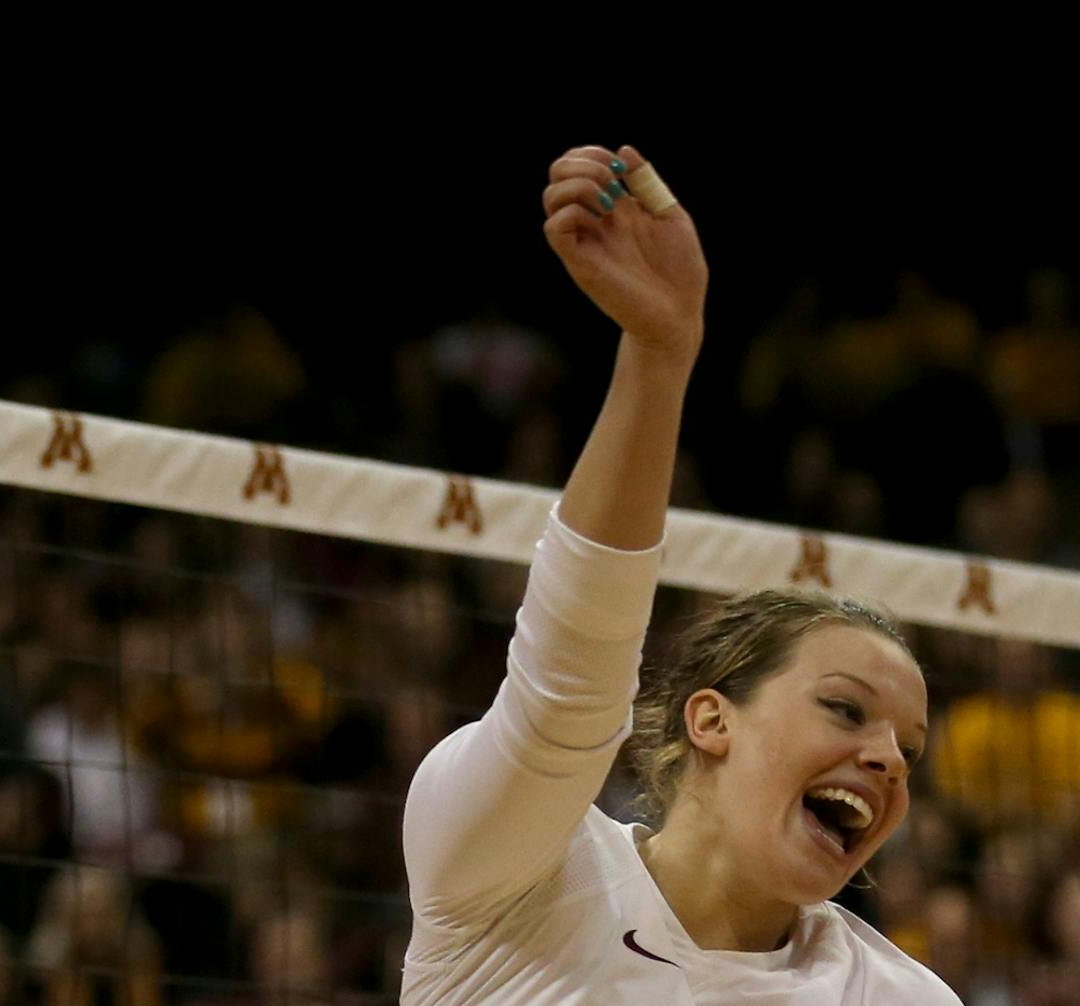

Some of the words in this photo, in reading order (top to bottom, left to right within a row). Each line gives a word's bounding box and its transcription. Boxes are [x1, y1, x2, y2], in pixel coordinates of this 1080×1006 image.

[40, 408, 93, 473] M
[242, 443, 292, 504] M
[436, 473, 482, 535] M
